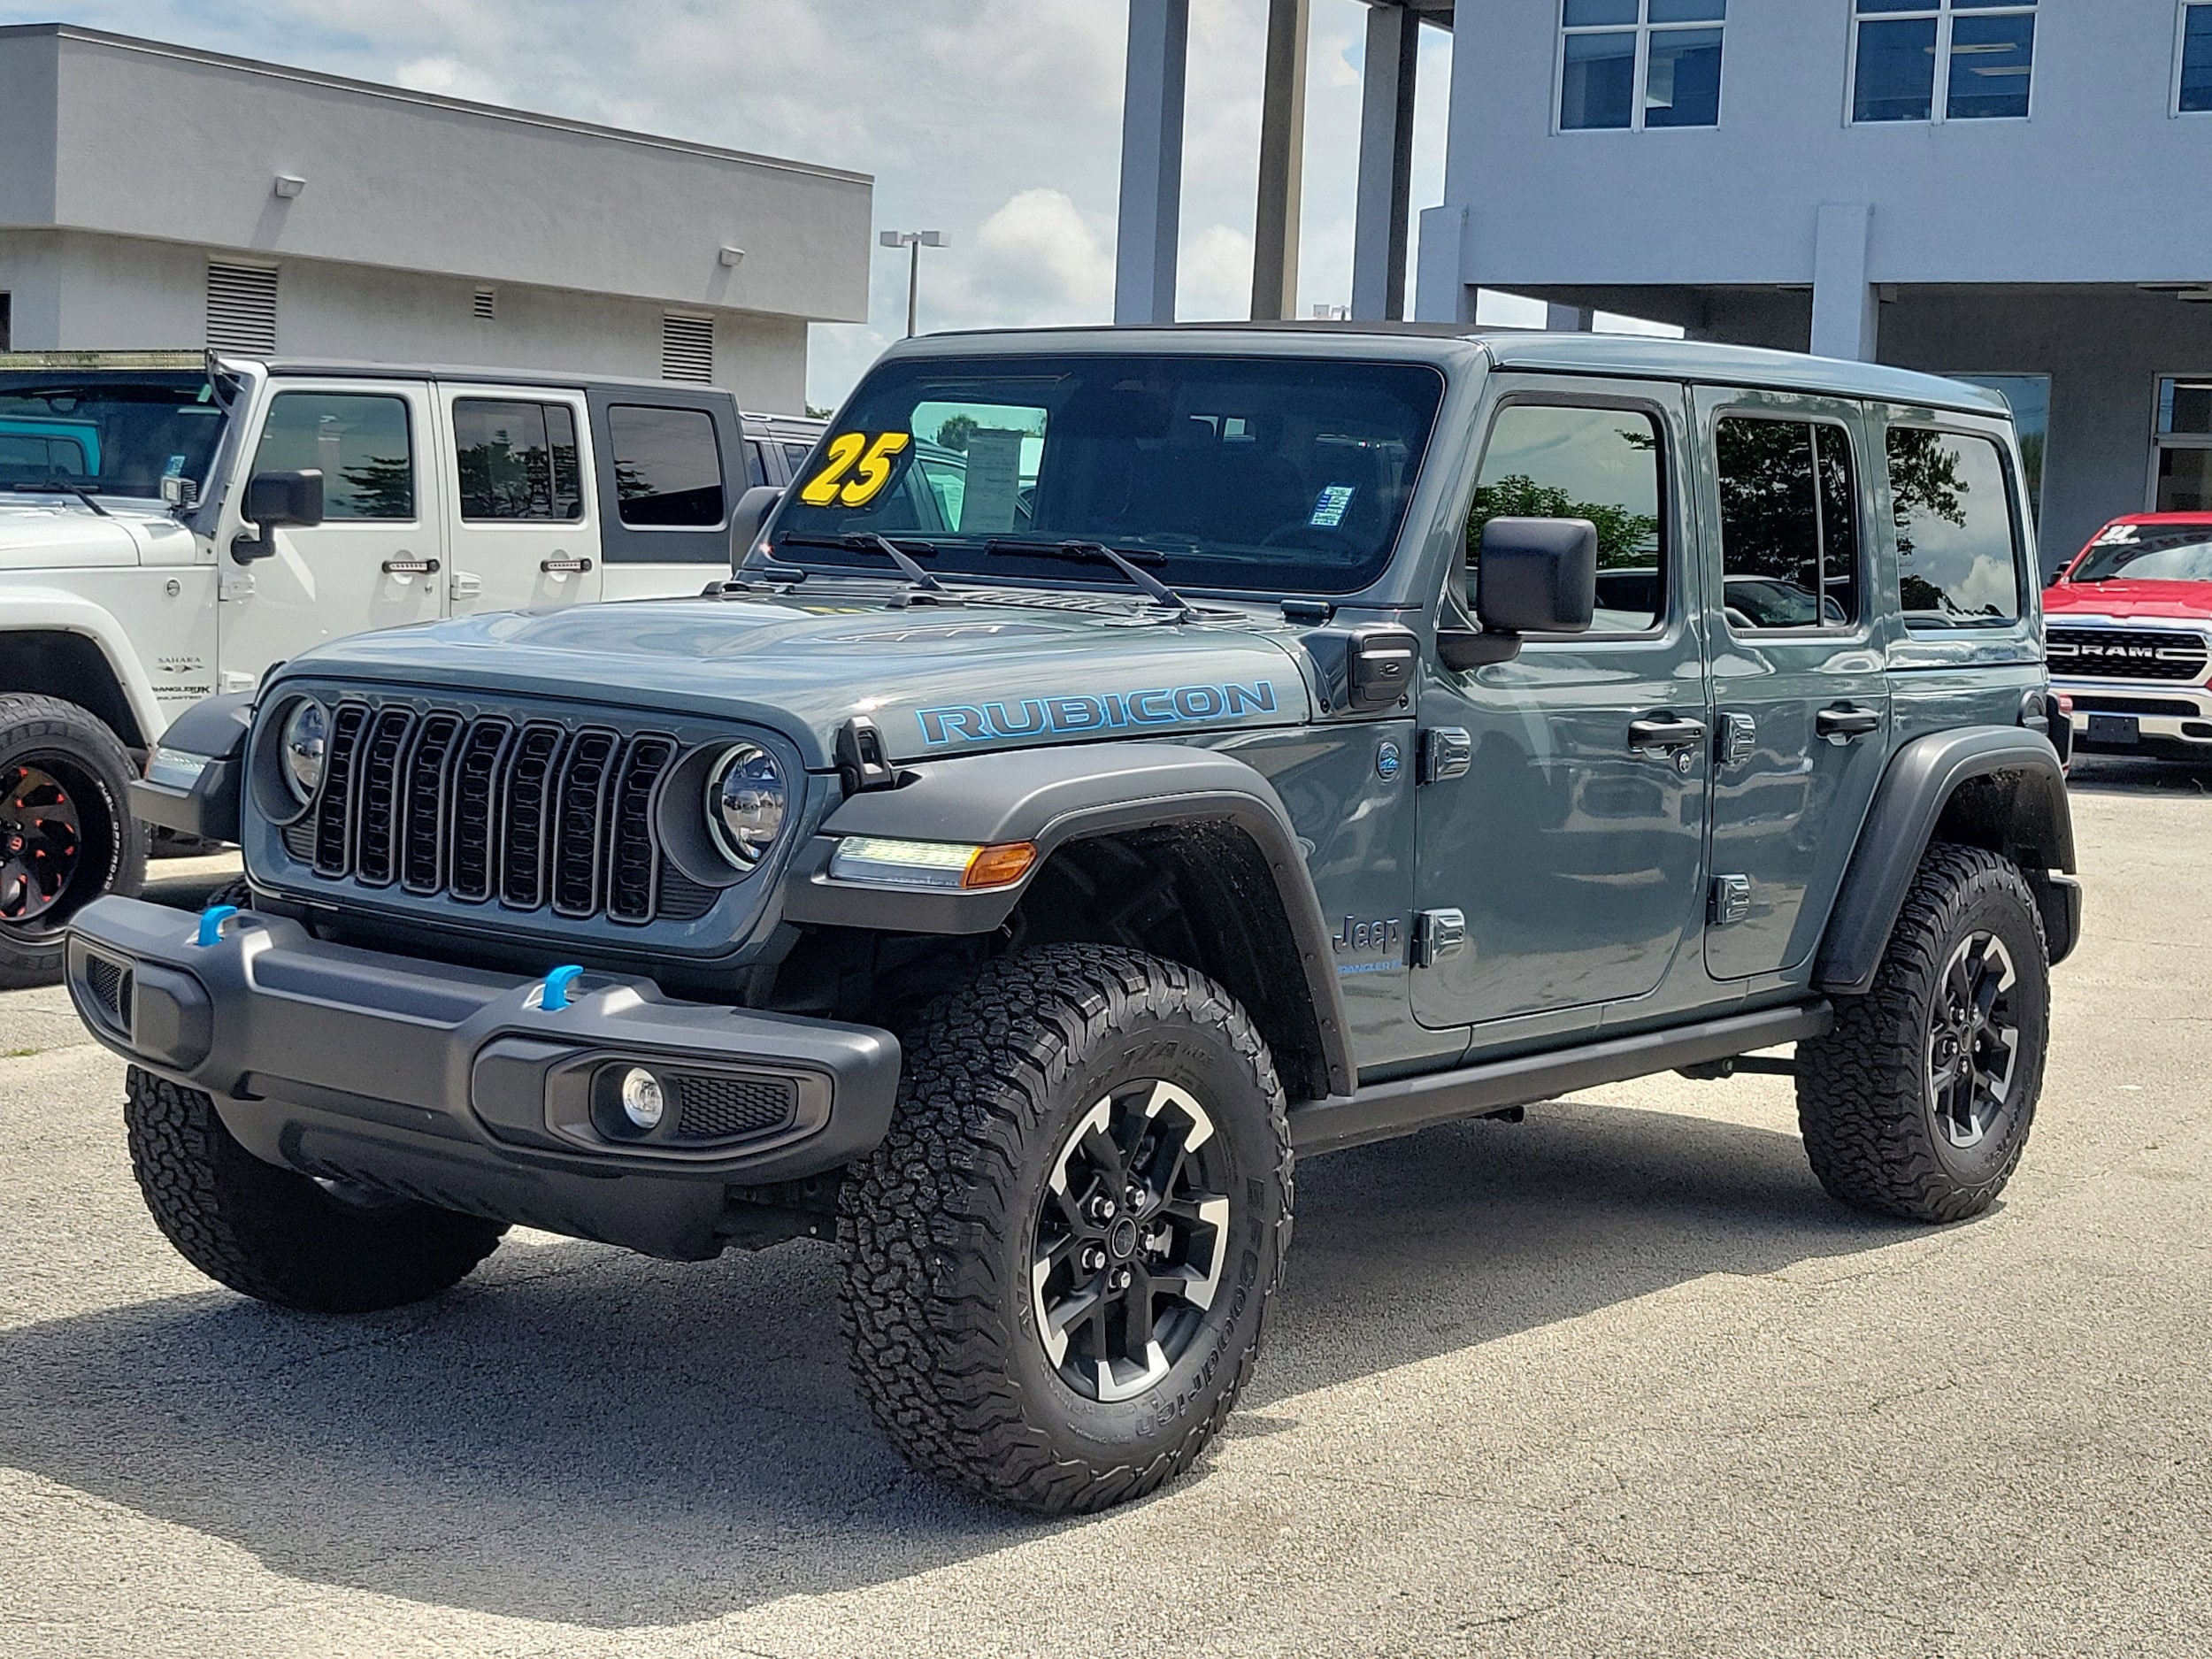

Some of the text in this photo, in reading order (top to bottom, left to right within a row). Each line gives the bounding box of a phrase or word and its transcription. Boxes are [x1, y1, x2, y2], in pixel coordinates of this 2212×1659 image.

[802, 433, 910, 507] 25
[2081, 645, 2153, 657] RAM
[916, 680, 1277, 745] RUBICON
[1333, 914, 1400, 954] Jeep
